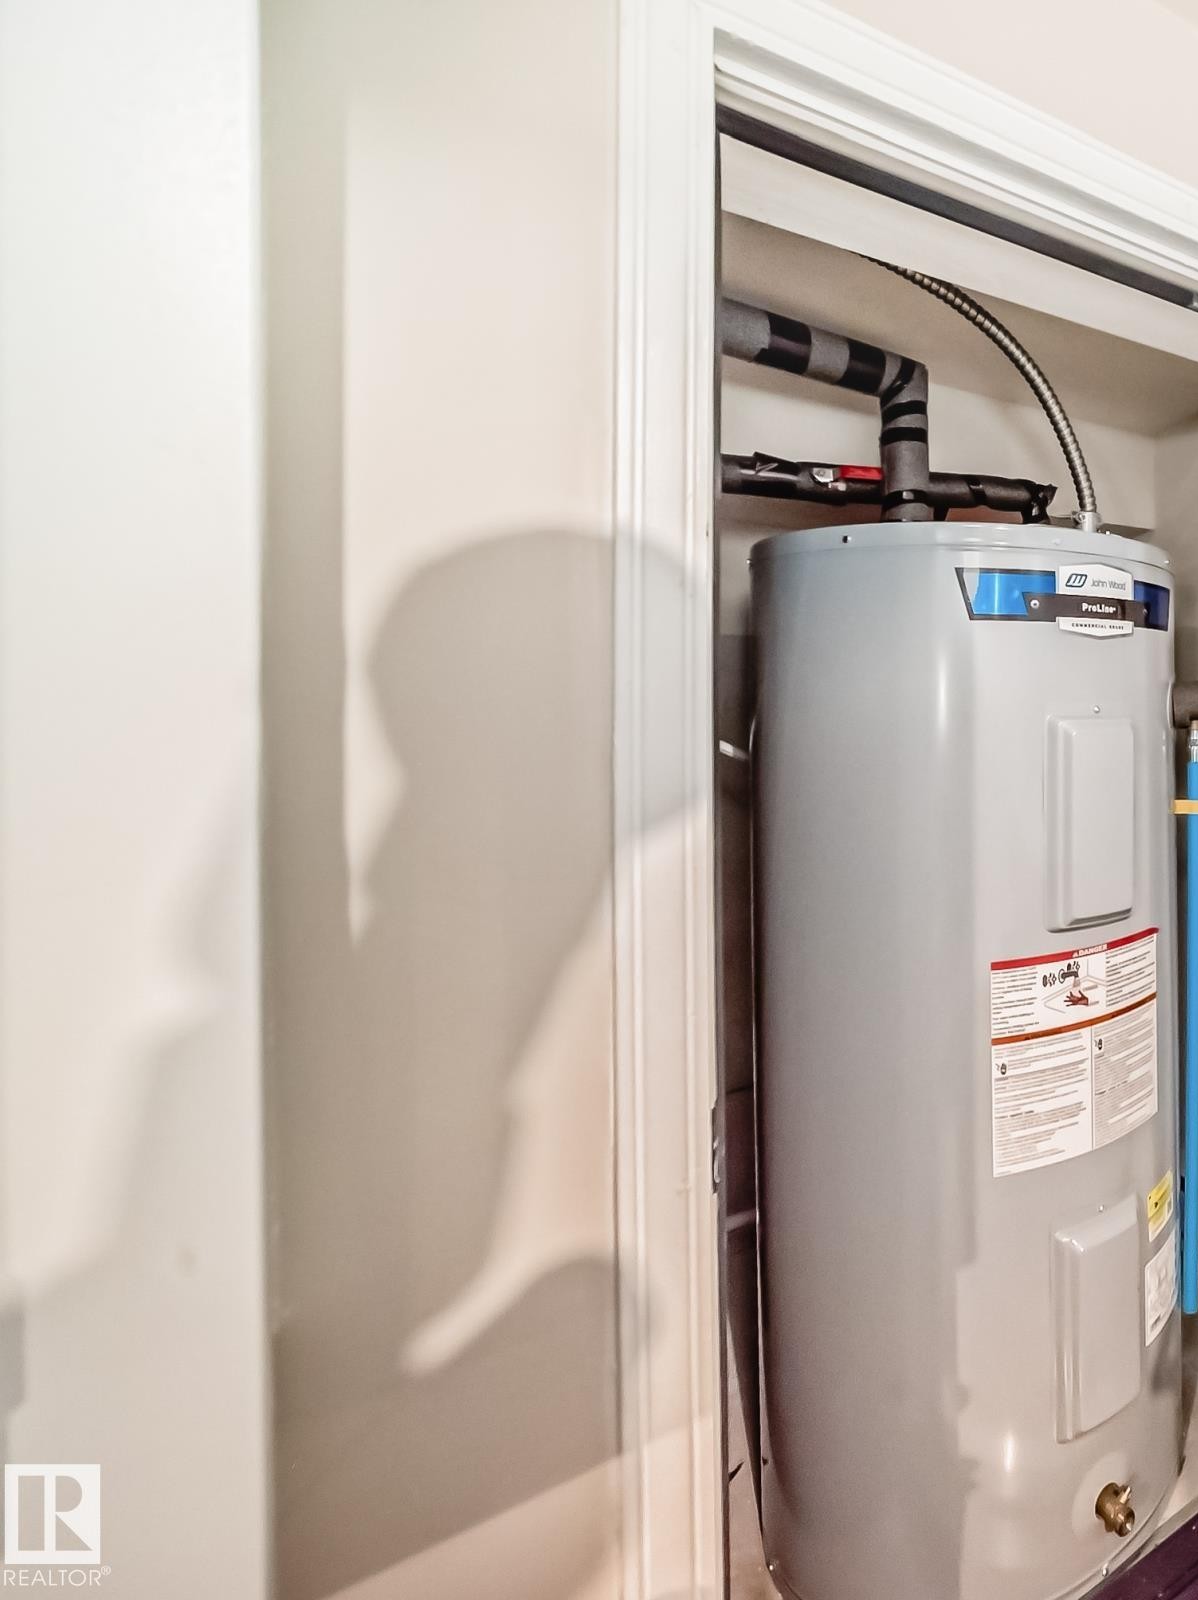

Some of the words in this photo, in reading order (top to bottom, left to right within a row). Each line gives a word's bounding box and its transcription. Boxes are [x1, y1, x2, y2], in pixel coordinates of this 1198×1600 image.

[1091, 578, 1108, 588] John
[1109, 579, 1126, 590] Wood
[1081, 602, 1115, 613] ProLine
[1078, 943, 1108, 957] DANGER
